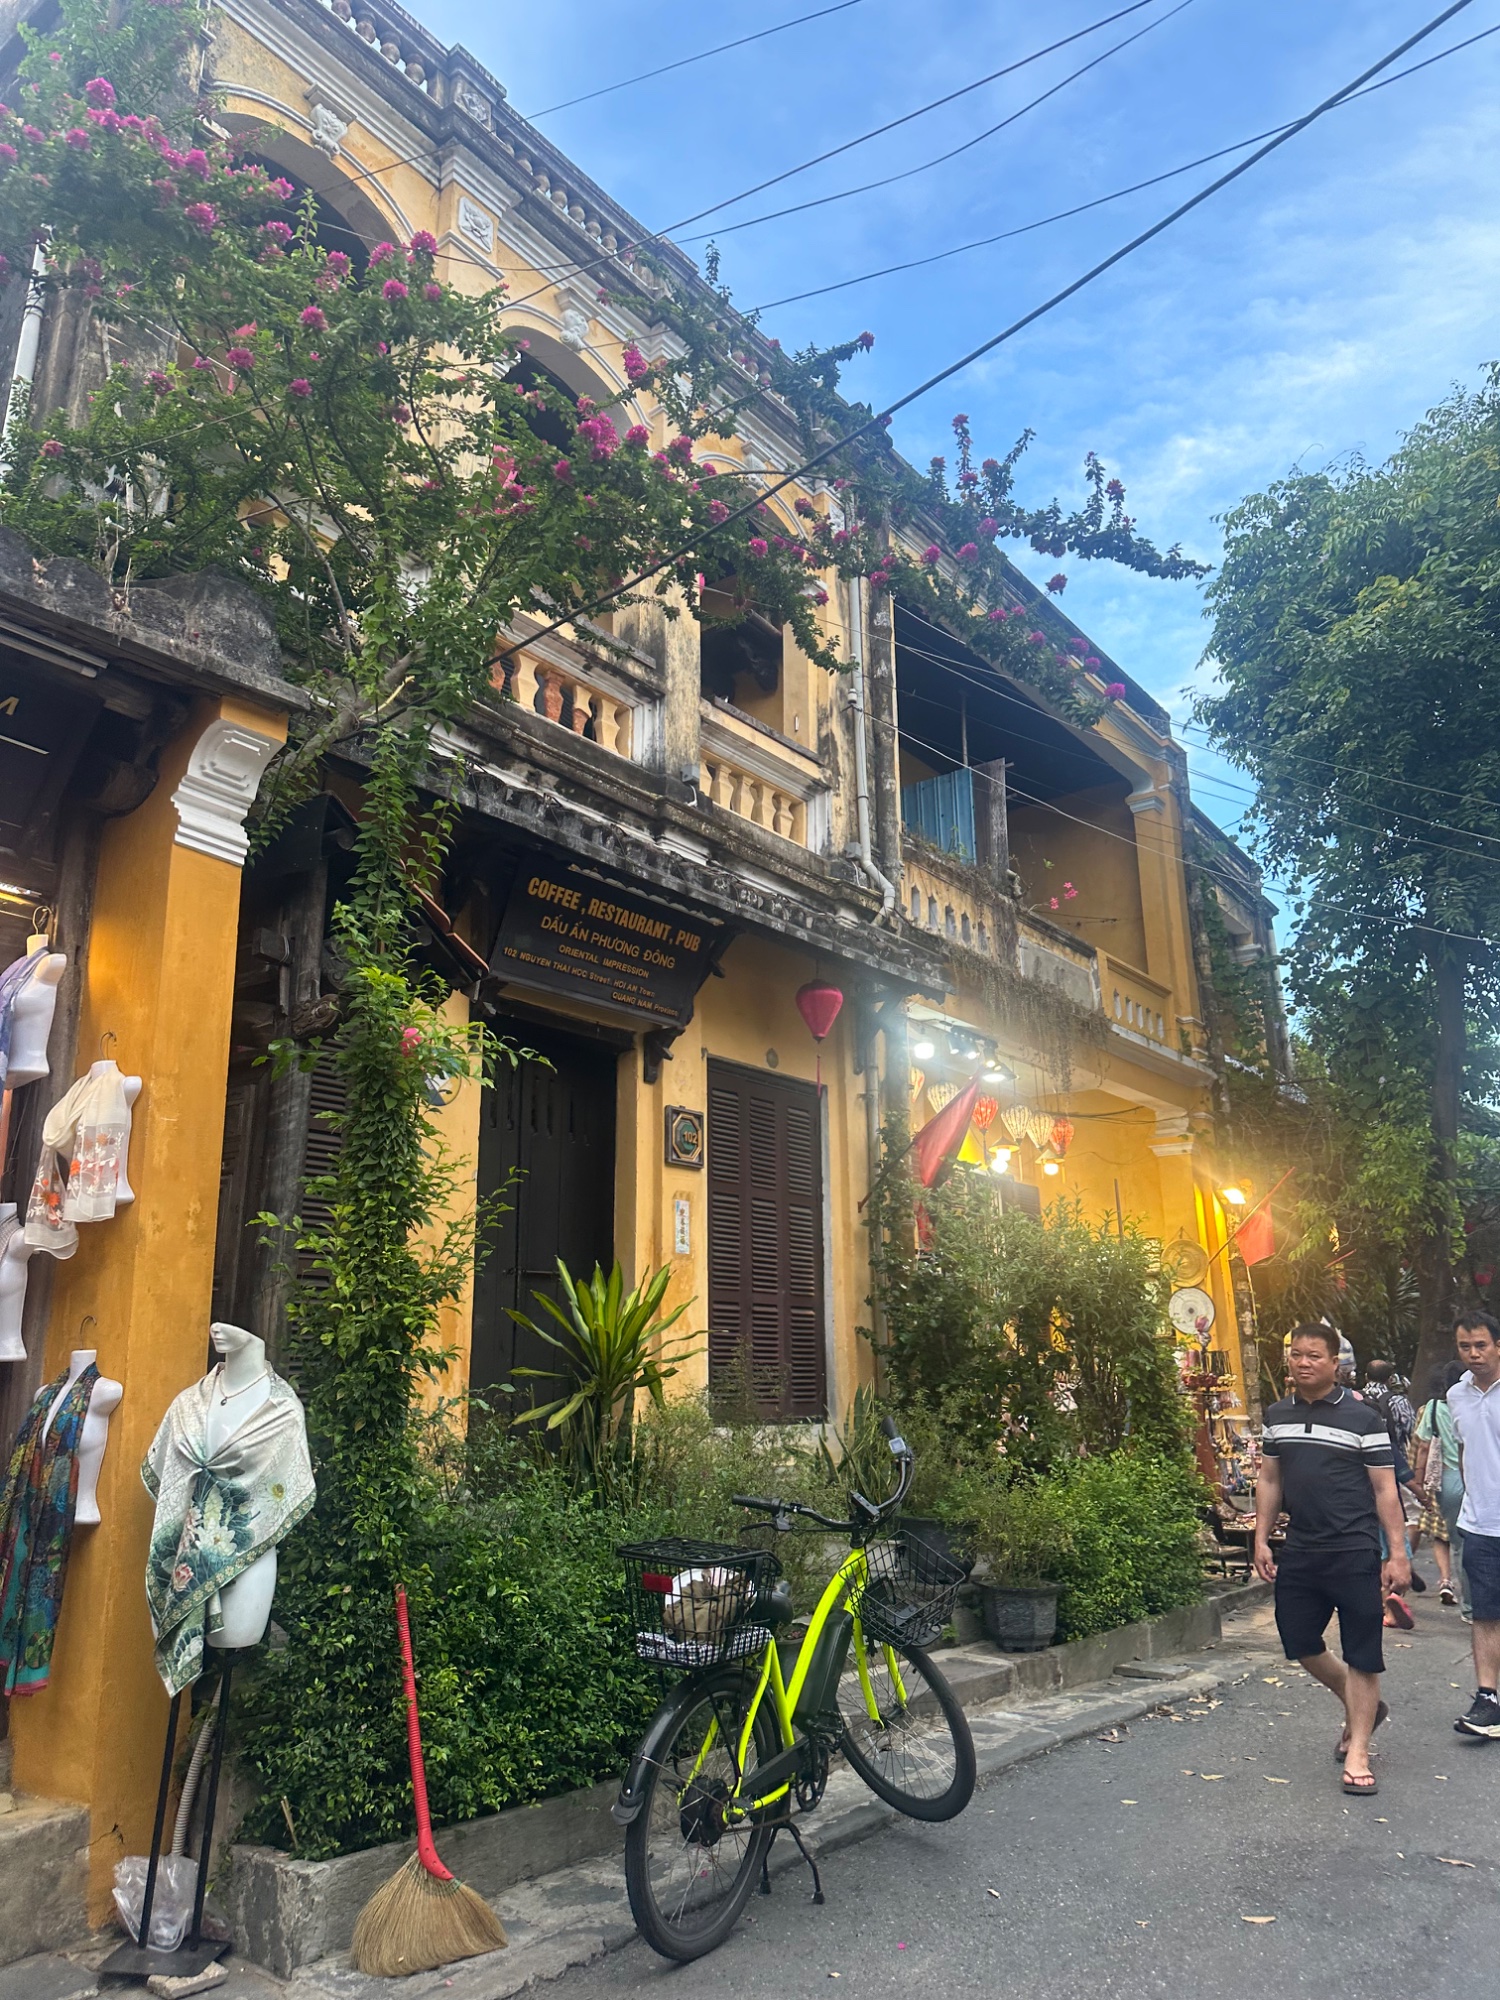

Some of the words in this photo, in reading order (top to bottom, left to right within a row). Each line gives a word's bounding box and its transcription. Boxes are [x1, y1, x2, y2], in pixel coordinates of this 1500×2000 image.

[541, 914, 569, 935] DẤU
[569, 921, 589, 942] ẤN
[590, 932, 640, 958] PHƯƠNG
[643, 948, 676, 969] ĐÔNG
[675, 929, 701, 952] PUB
[503, 946, 518, 958] 102
[519, 951, 552, 967] NGUYEN
[553, 961, 571, 973] THAI
[571, 966, 588, 978] HOC
[613, 979, 626, 989] HOI
[627, 983, 638, 993] AN
[558, 944, 599, 964] ORIENTAL
[602, 958, 650, 979] IMPRESSION
[612, 991, 637, 1005] QUANG
[637, 1000, 653, 1010] NAM
[683, 1130, 698, 1144] 102
